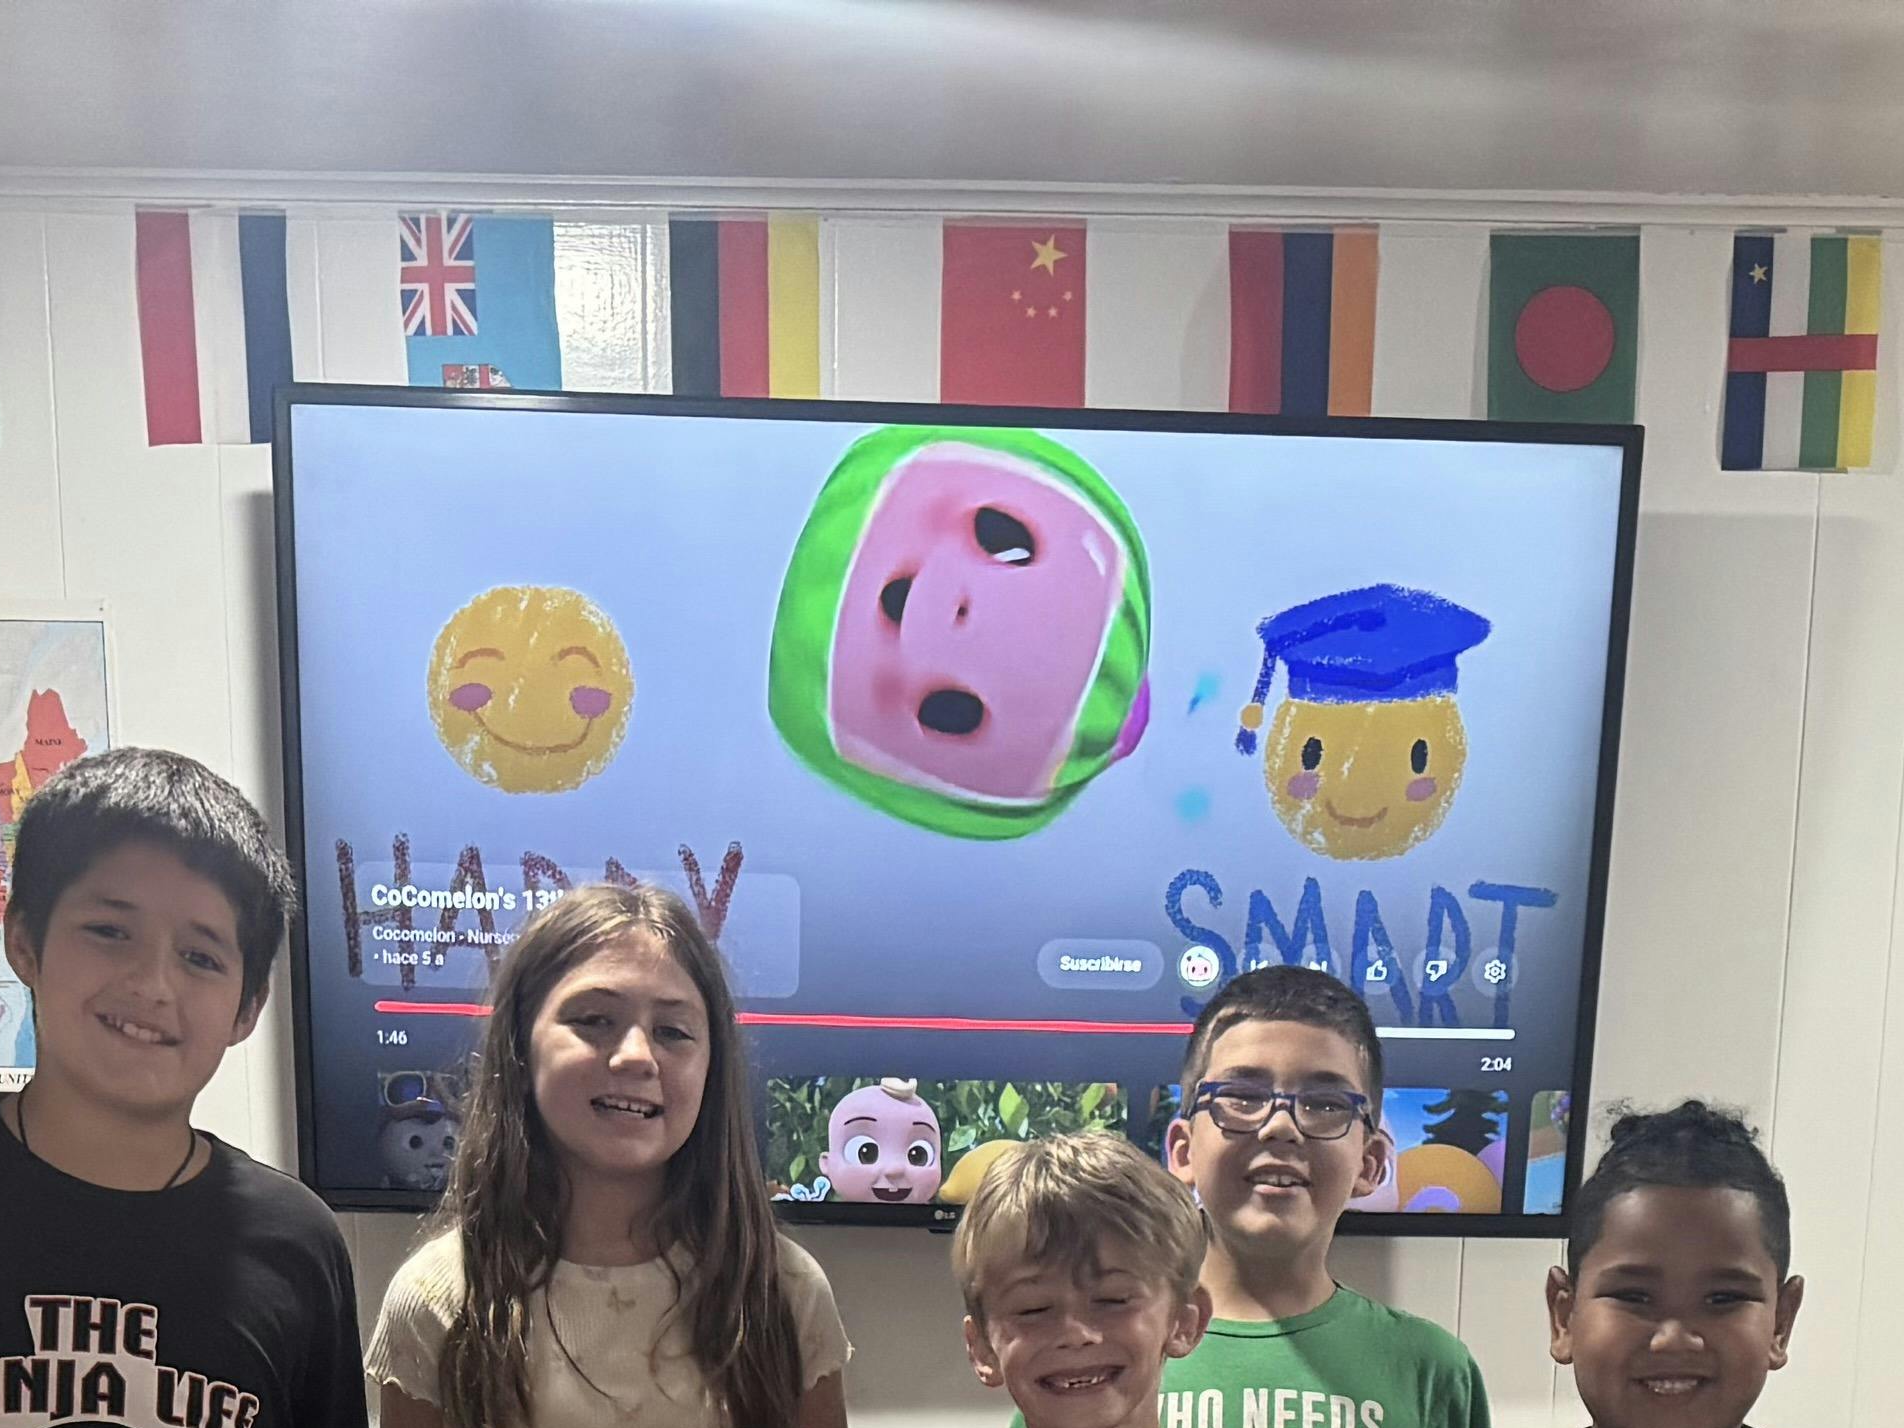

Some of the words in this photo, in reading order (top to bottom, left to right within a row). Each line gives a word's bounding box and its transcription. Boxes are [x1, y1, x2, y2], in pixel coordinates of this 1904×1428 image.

[372, 883, 515, 912] CoComelon's
[373, 927, 456, 944] Cocomelon
[382, 951, 418, 966] hace
[422, 952, 431, 965] 5
[435, 954, 443, 965] a
[1059, 955, 1142, 973] Suscribirse
[376, 1028, 407, 1046] 1:46
[1481, 1057, 1513, 1072] 2:04
[30, 1298, 156, 1359] THE
